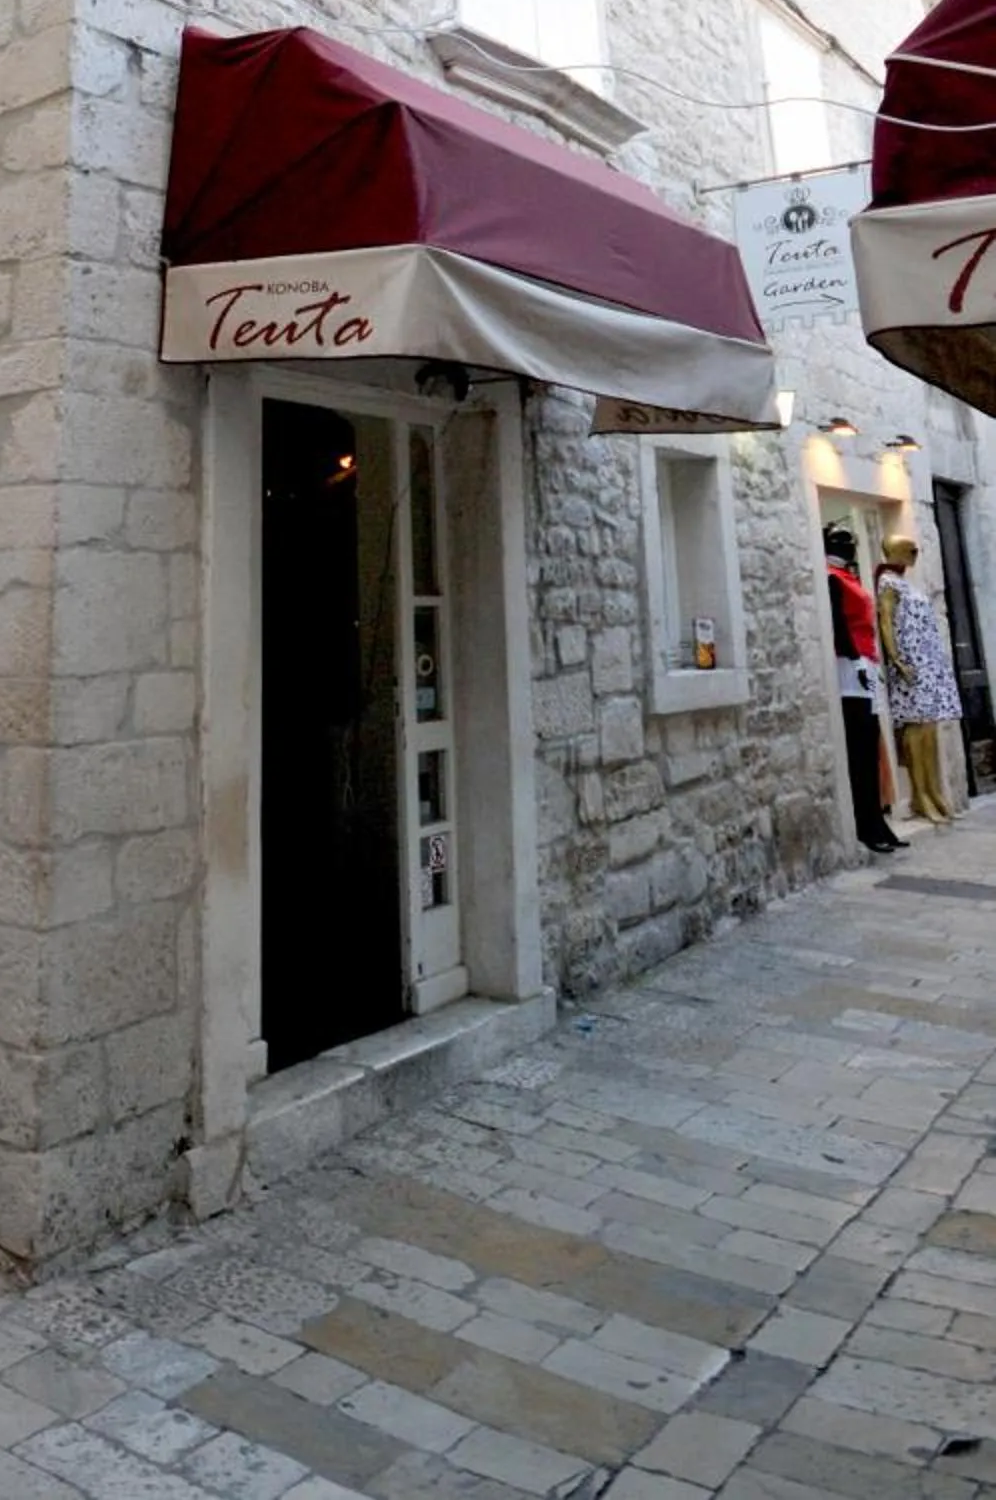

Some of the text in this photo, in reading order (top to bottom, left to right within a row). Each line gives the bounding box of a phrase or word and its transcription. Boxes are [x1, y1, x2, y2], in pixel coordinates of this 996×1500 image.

[266, 280, 330, 295] KONOBA
[763, 277, 847, 296] Garden
[205, 284, 373, 350] Teuta
